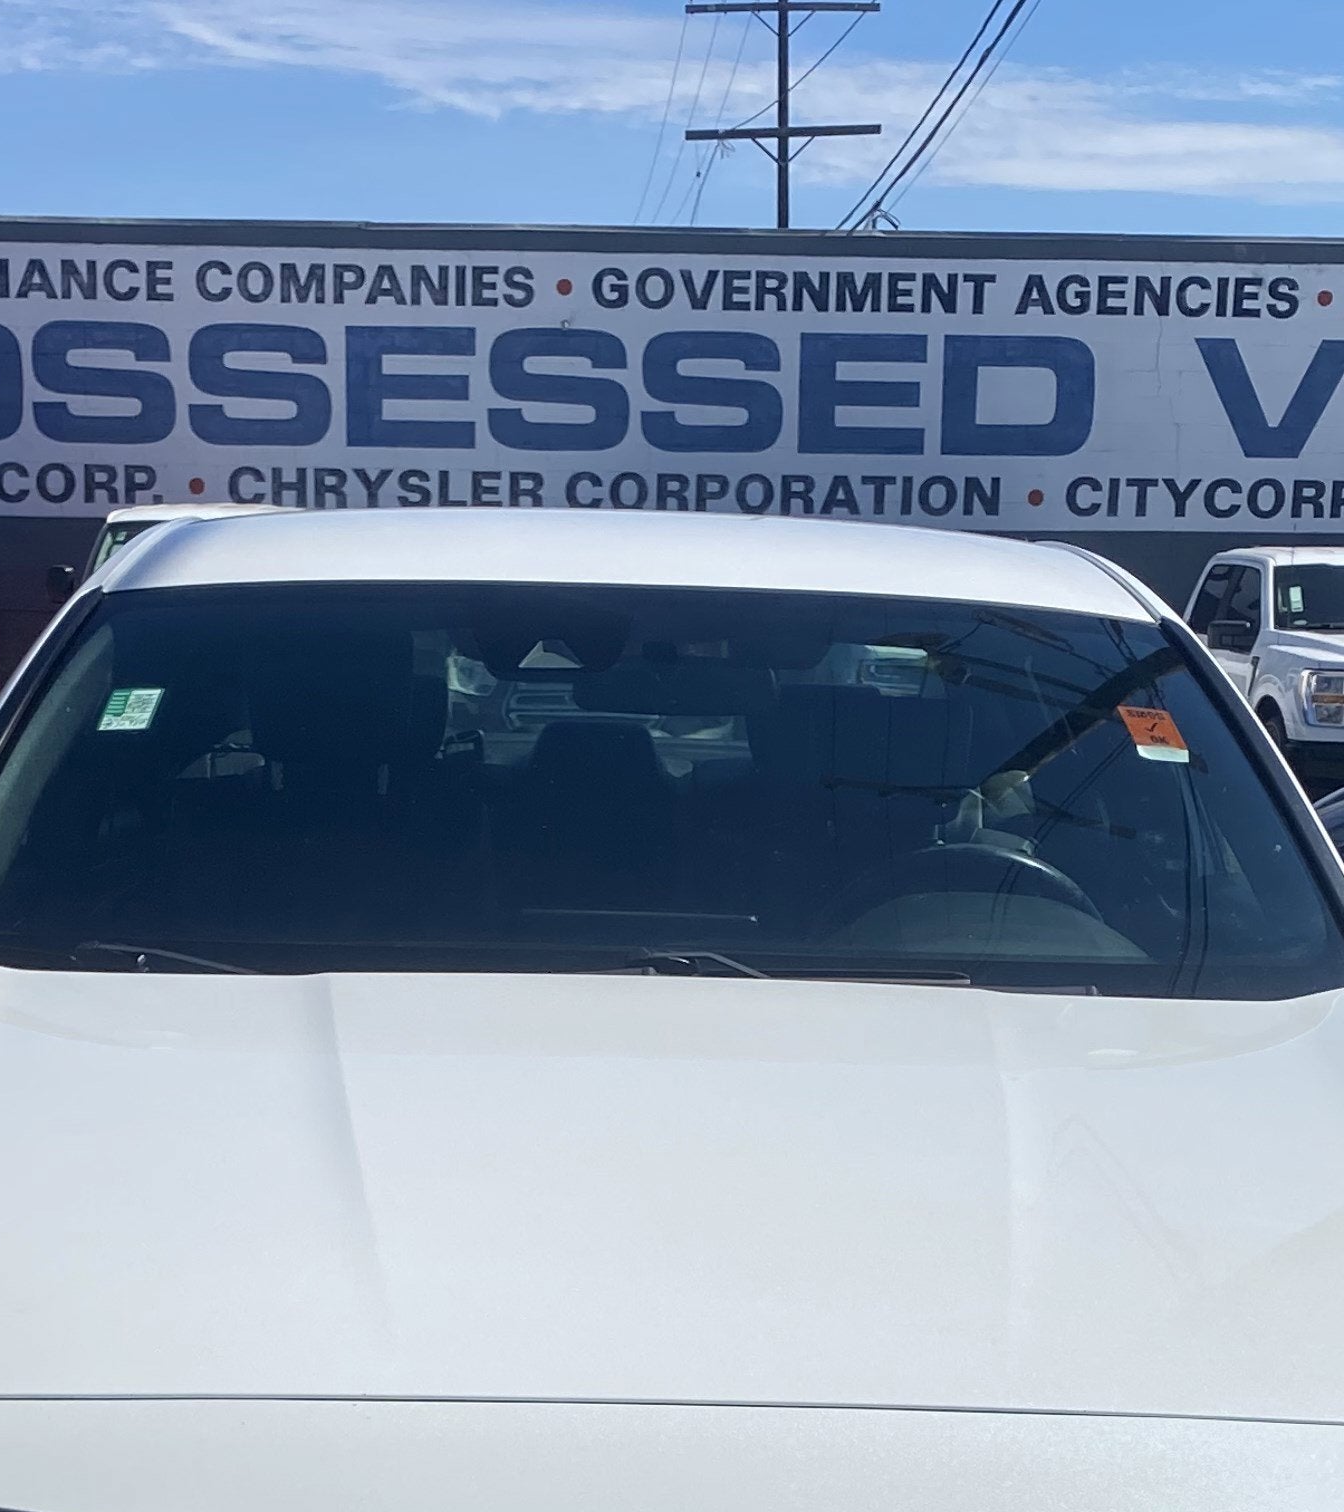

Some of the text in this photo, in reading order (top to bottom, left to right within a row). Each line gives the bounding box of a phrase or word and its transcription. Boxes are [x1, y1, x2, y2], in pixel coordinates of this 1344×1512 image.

[194, 260, 536, 308] COMPANIES
[591, 267, 997, 315] GOVERNMENT
[1015, 274, 1301, 319] AGENCIES
[227, 465, 545, 509] CHRYSLER
[565, 471, 1002, 516] CORPORATION
